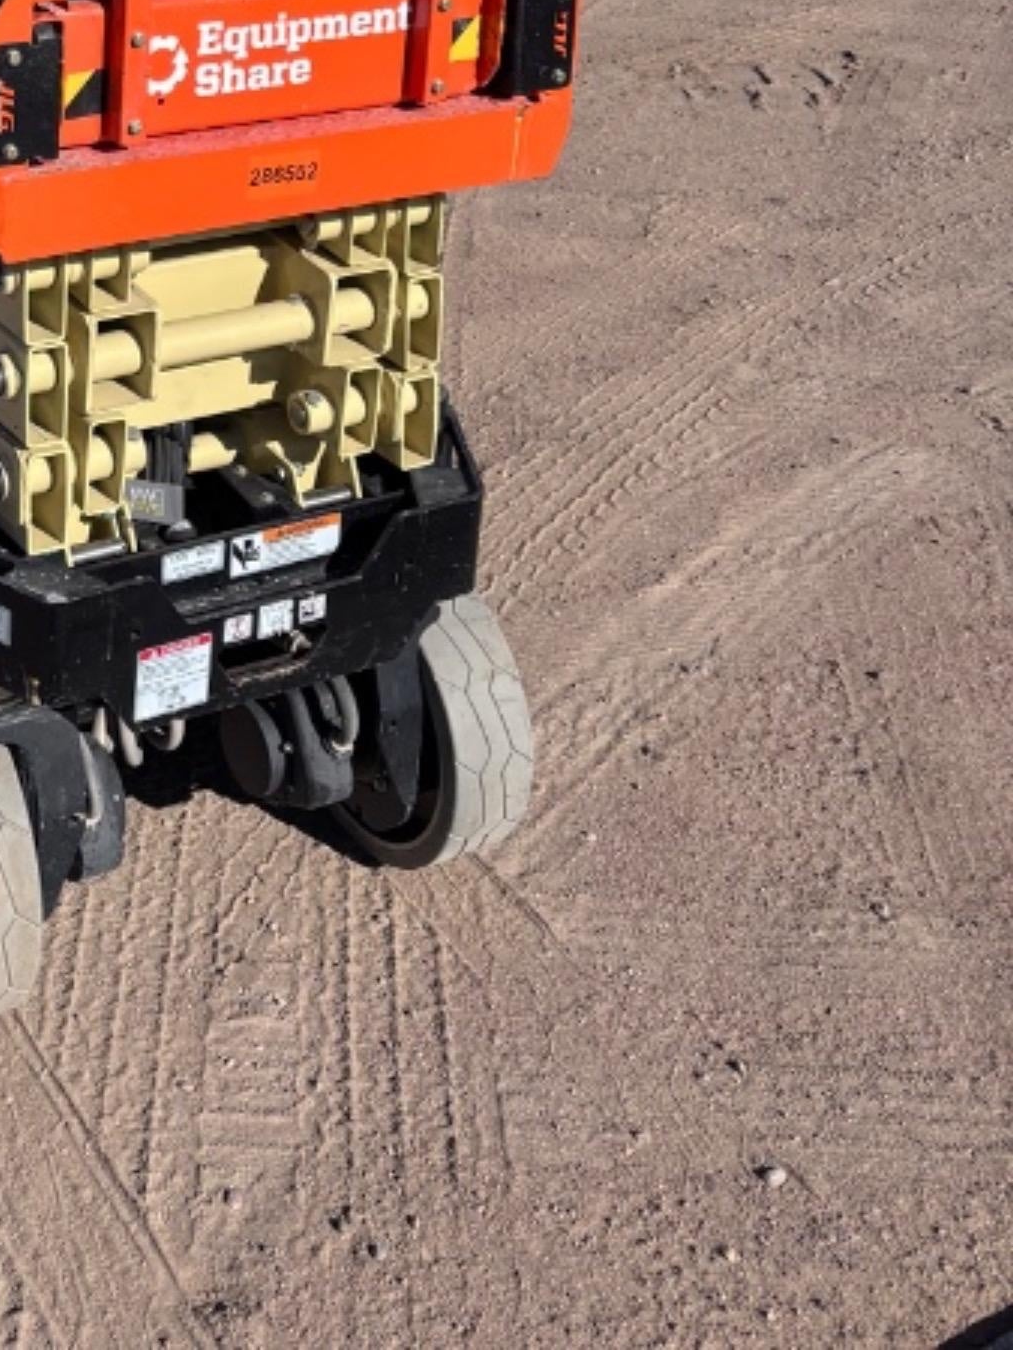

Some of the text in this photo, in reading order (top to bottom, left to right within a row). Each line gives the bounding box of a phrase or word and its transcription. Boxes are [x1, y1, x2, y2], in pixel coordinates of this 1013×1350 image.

[196, 0, 412, 59] Equipment
[194, 58, 312, 96] Share
[249, 161, 319, 187] 286552
